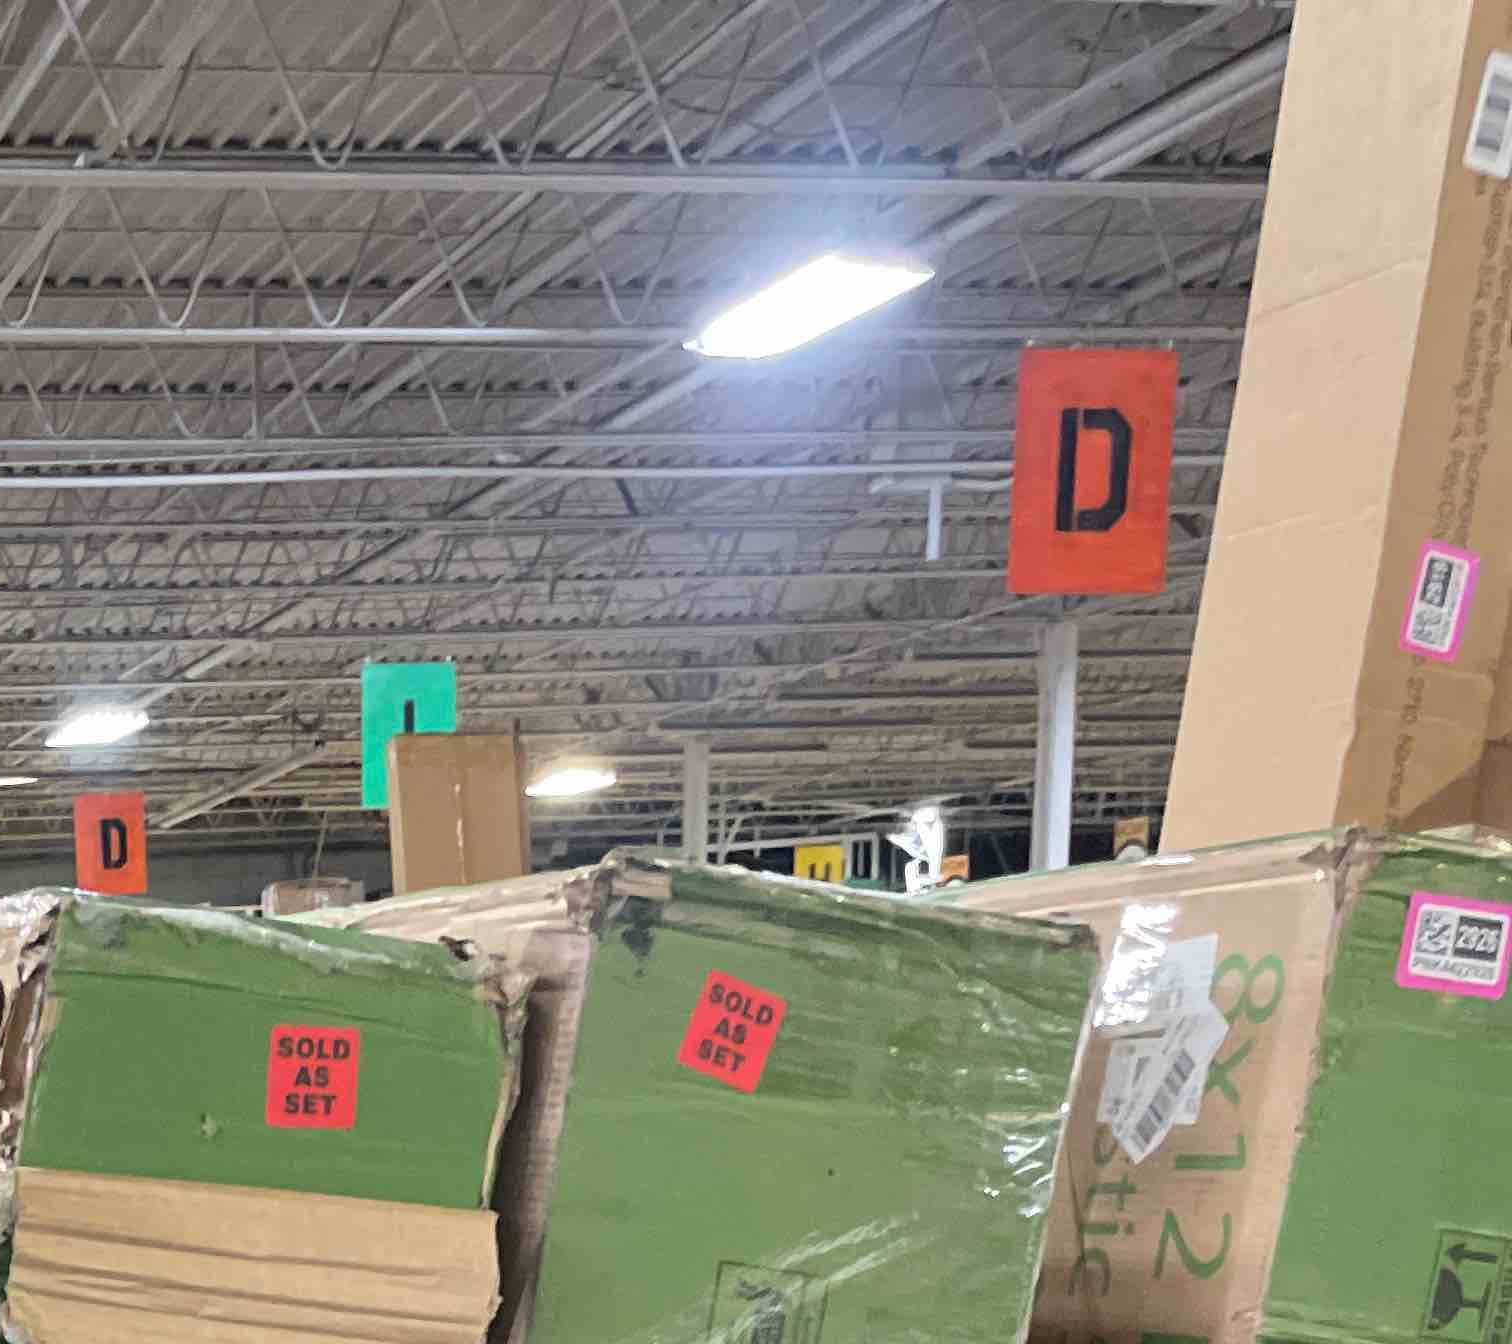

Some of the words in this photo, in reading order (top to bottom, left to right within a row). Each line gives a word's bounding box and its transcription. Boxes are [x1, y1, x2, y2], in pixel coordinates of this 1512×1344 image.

[1056, 406, 1134, 533] D
[100, 818, 128, 870] D
[708, 980, 776, 1029] SOLD
[276, 1035, 352, 1063] SOLD
[713, 1015, 749, 1047] AS
[697, 1036, 747, 1075] SET
[294, 1066, 331, 1090] AS
[284, 1092, 338, 1117] SET
[1068, 1123, 1137, 1296] stic
